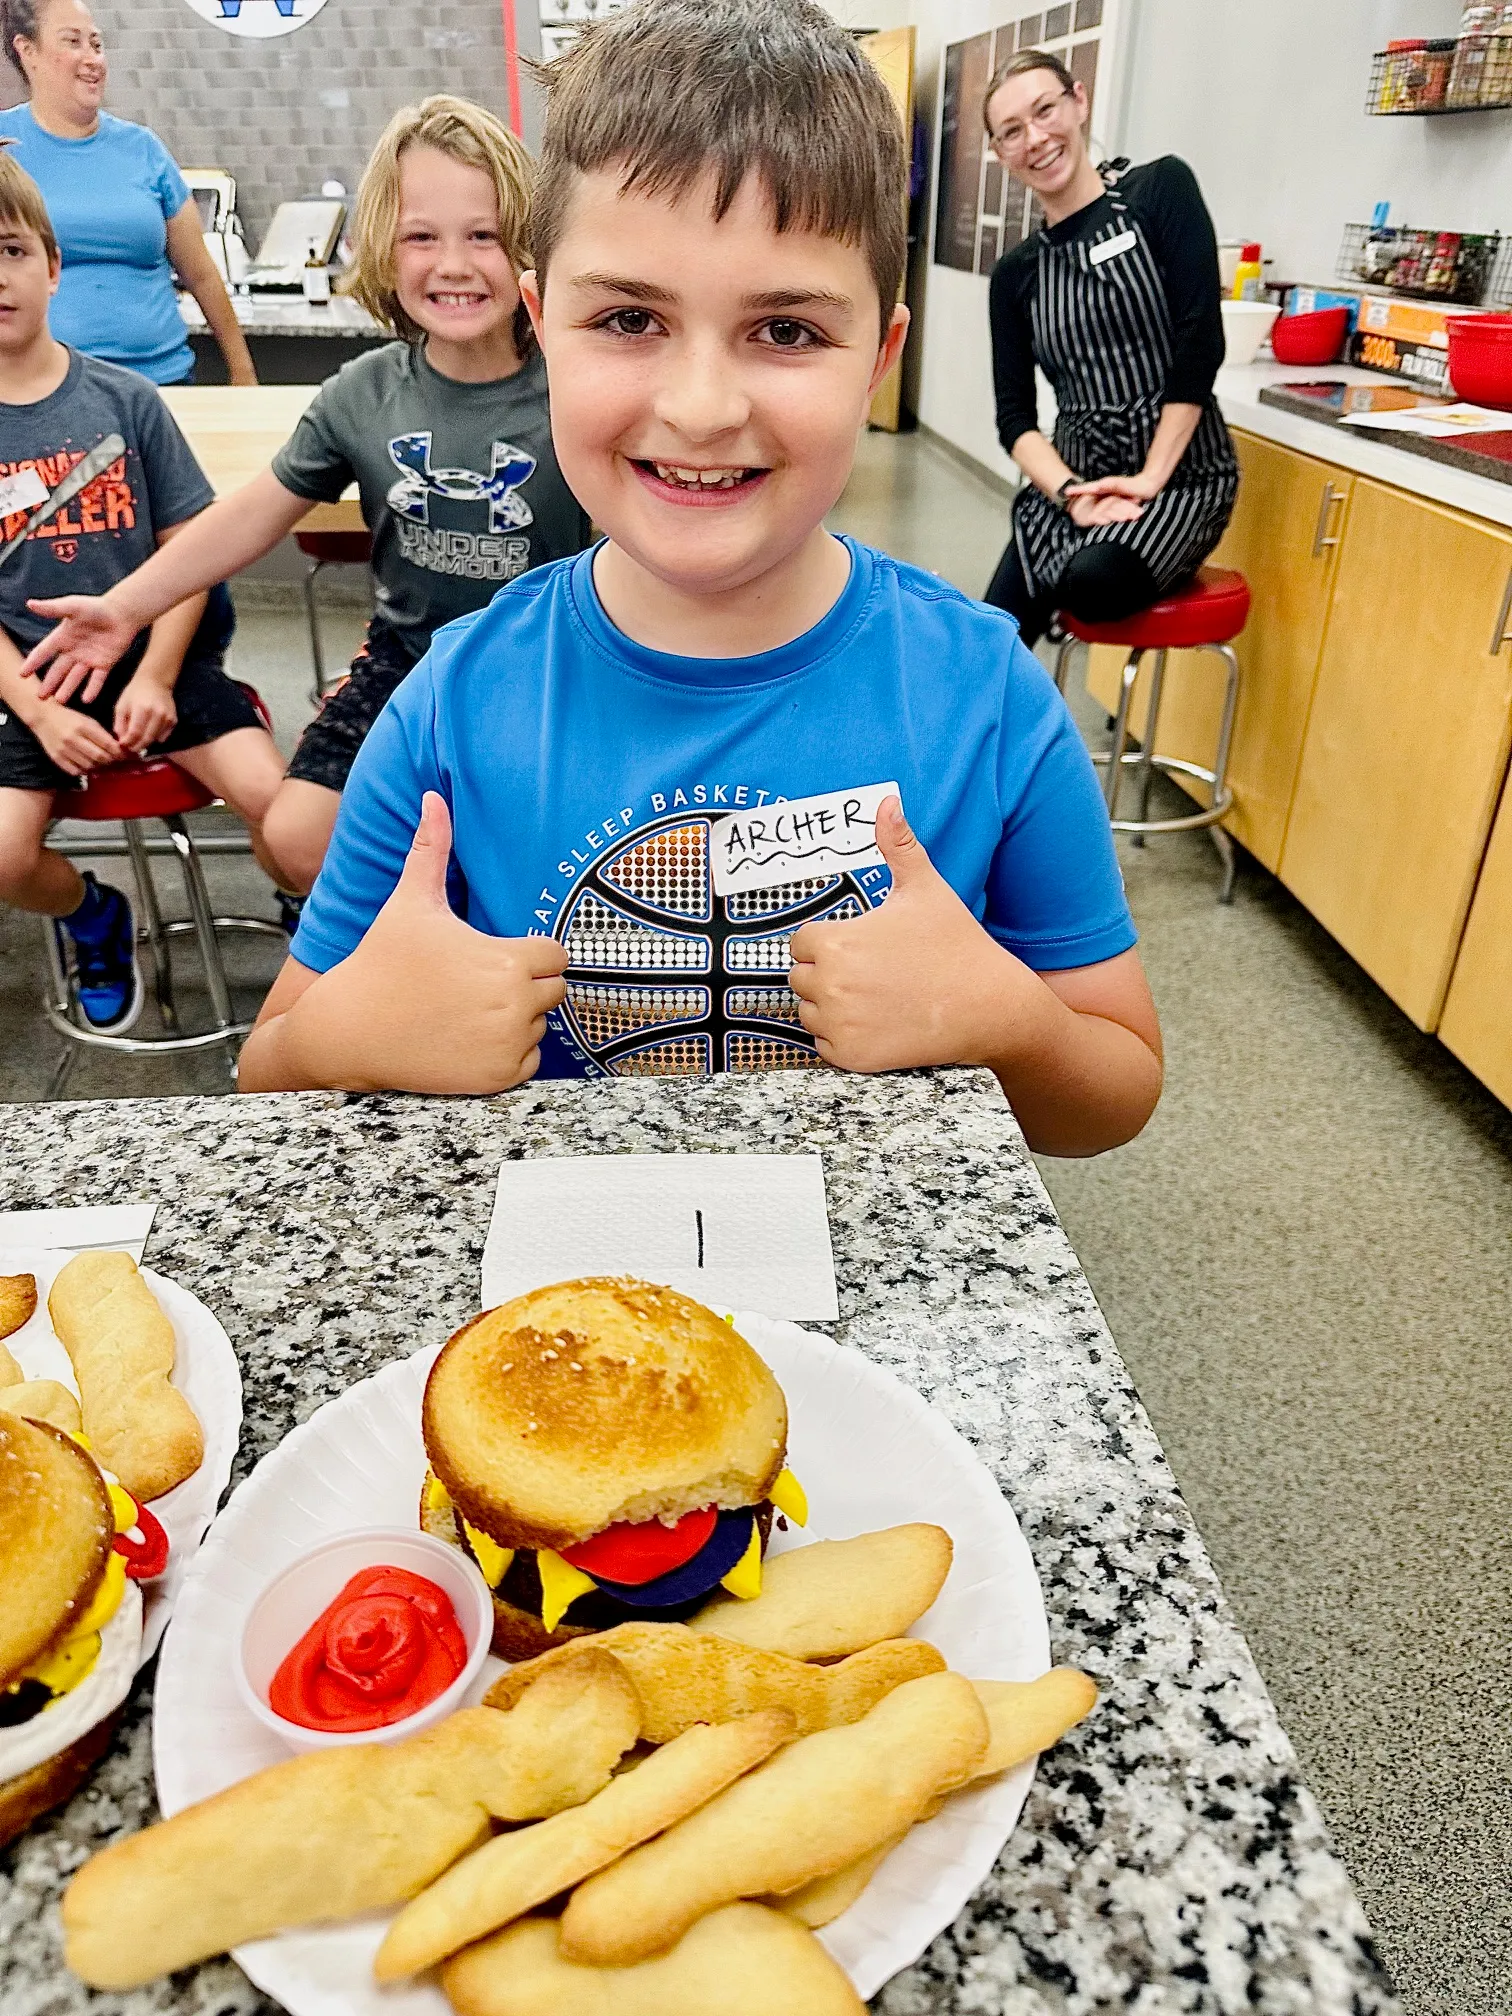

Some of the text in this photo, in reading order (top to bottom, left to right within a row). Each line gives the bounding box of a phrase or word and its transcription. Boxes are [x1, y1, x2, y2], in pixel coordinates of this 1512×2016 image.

[395, 518, 531, 560] UNDER
[557, 807, 634, 878] SLEEP
[651, 785, 788, 812] BASKET
[724, 799, 876, 854] ARCHER
